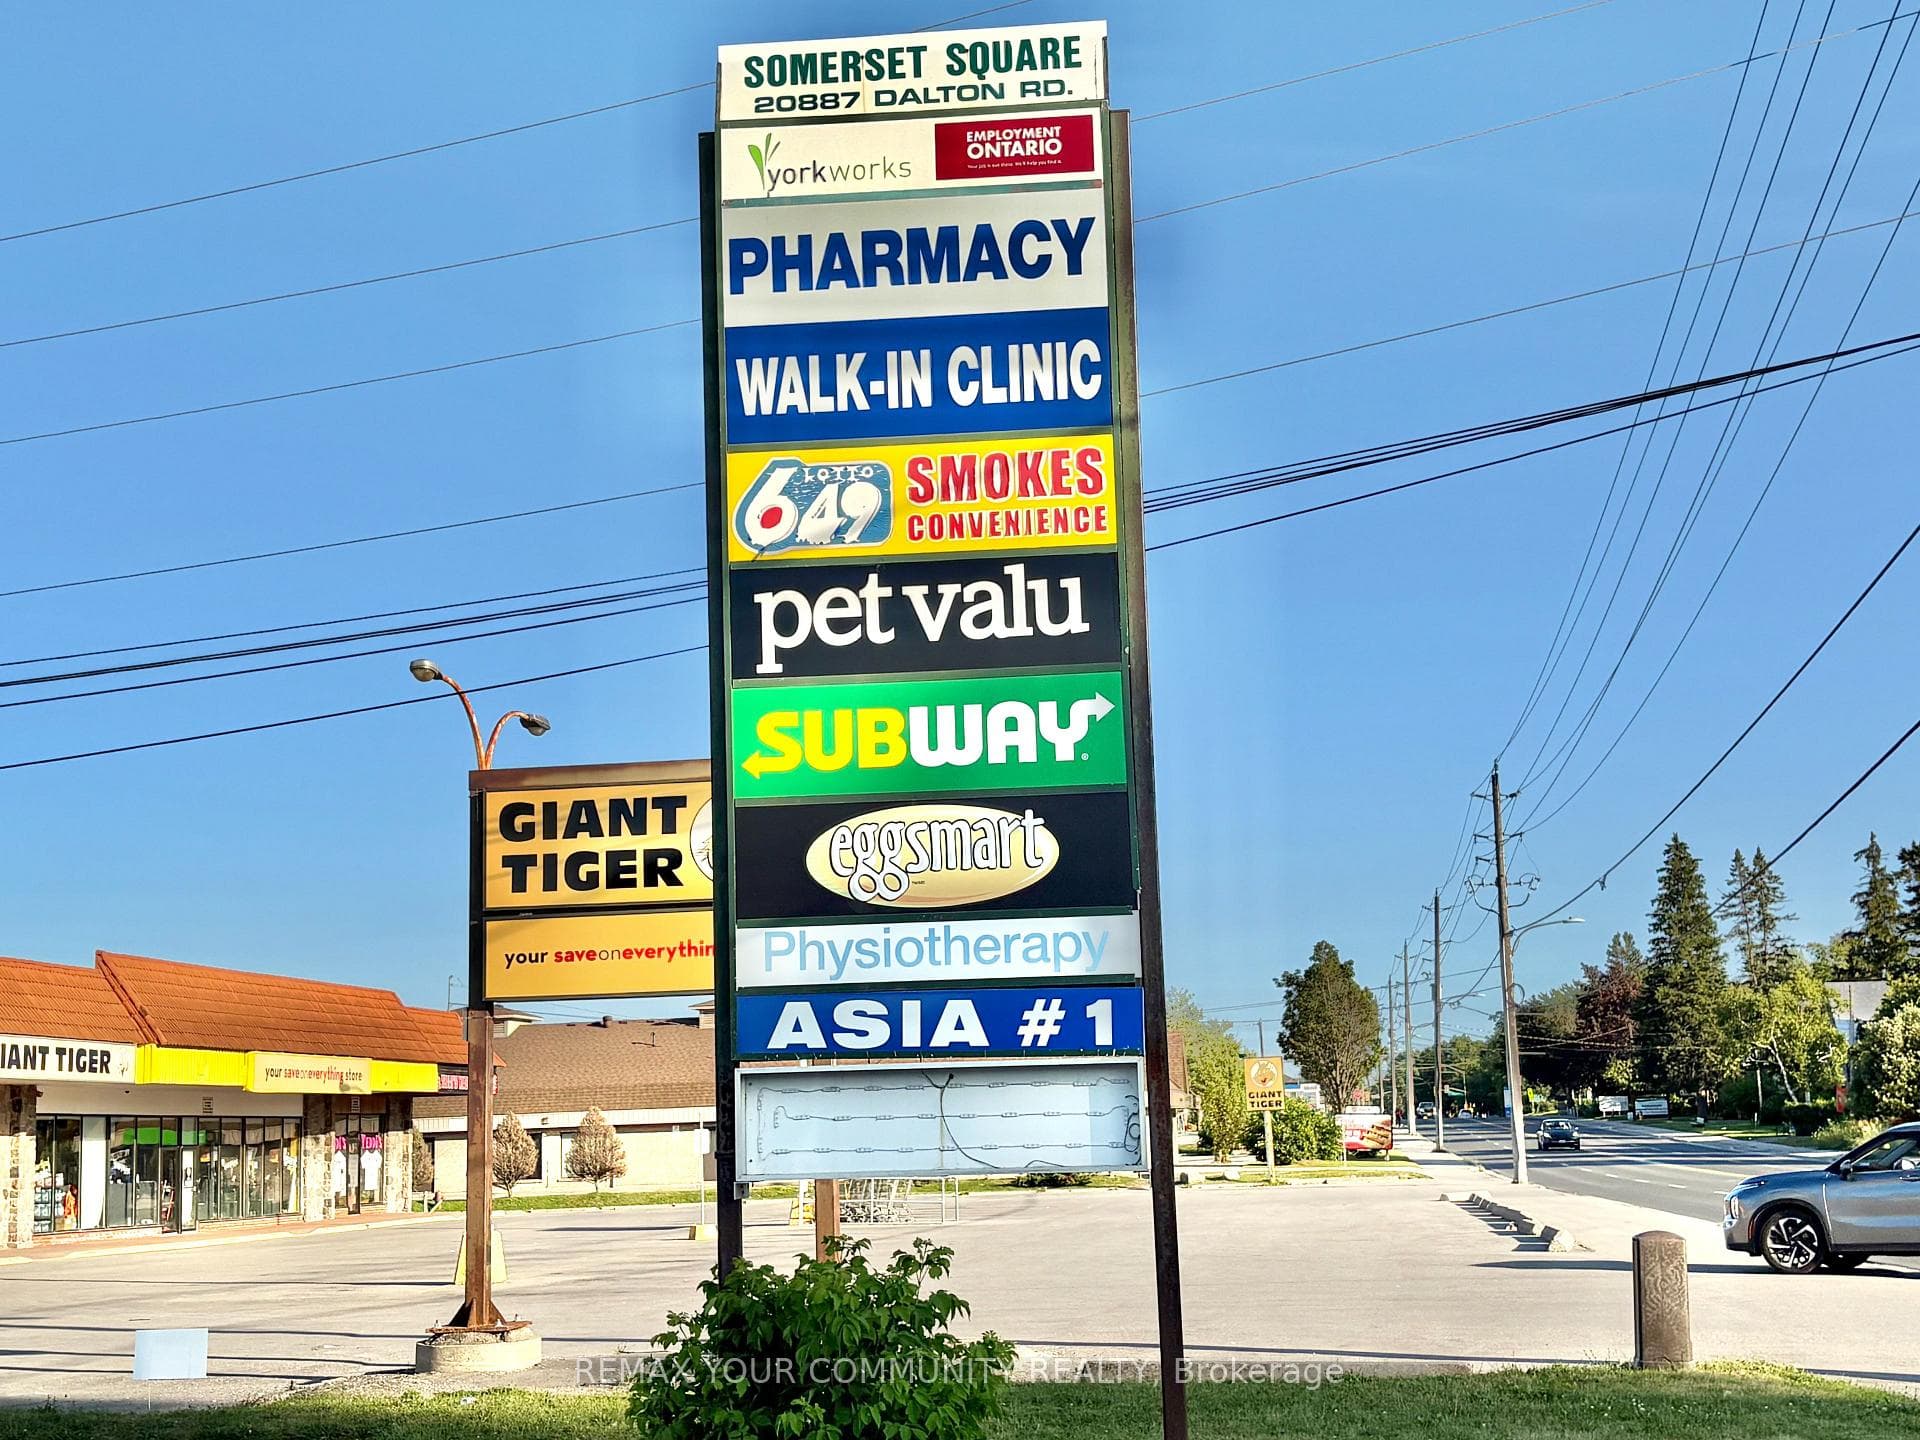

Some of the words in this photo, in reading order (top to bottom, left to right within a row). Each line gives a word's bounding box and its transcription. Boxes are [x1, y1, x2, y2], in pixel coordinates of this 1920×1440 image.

[744, 46, 928, 88] SOMERSET
[946, 35, 1083, 80] SQUARE
[754, 92, 861, 113] 20887
[874, 82, 1005, 107] DALTON
[1020, 79, 1073, 98] RD.
[966, 126, 1062, 142] EMPLOYMENT
[966, 138, 1063, 159] ONTARIO
[767, 155, 912, 196] yorkworks
[728, 216, 1096, 295] PHARMACY
[735, 348, 933, 416] WALK-IN
[946, 338, 1103, 407] CLINIC
[906, 447, 1105, 504] SMOKES
[907, 504, 1108, 542] CONVENIENCE
[753, 573, 896, 674] pet
[902, 563, 1091, 642] valu
[741, 691, 1116, 780] SUBWAY
[499, 795, 688, 843] GIANT
[501, 847, 684, 893] TIGER
[829, 808, 1046, 903] eggsmart
[504, 950, 549, 970] your
[553, 939, 716, 964] saveoneverythin
[764, 925, 1110, 981] Physiotherapy
[766, 999, 990, 1050] ASIA
[1016, 998, 1066, 1048] #
[1086, 998, 1114, 1047] 1
[0, 1043, 50, 1071] IANT
[55, 1046, 111, 1074] TIGER
[265, 1067, 282, 1082] your
[345, 1067, 363, 1081] store
[1248, 1090, 1283, 1099] GIANT
[1249, 1099, 1283, 1108] TIGER
